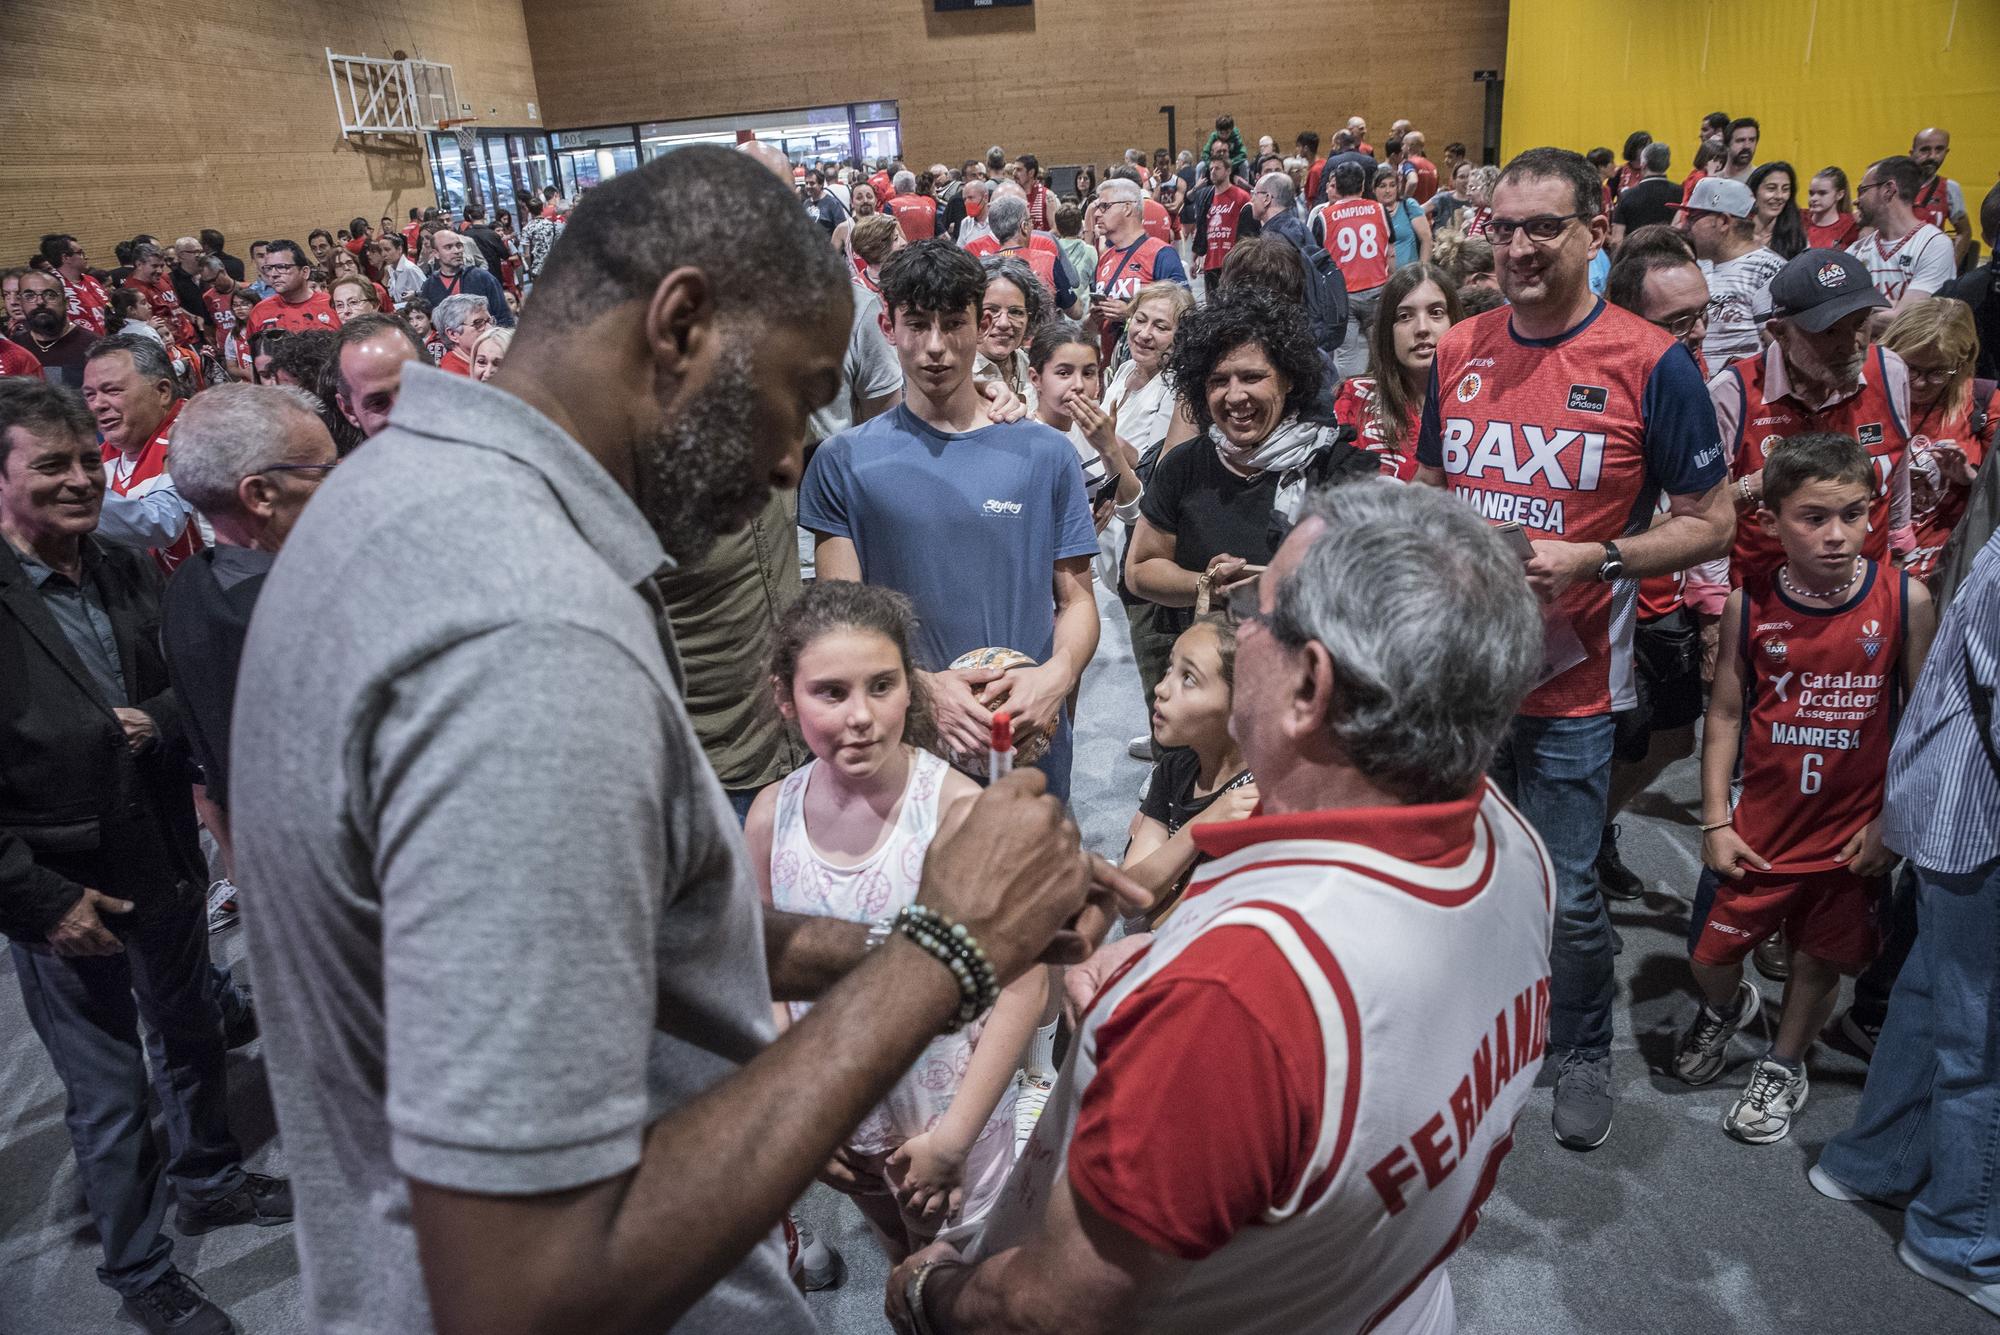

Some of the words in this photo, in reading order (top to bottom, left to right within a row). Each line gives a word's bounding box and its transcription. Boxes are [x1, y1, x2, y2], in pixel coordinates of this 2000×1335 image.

[1331, 204, 1376, 221] CAMPIONS
[1337, 223, 1378, 263] 98
[1819, 267, 1846, 282] BAXI
[1442, 417, 1607, 491] BAXI
[1771, 721, 1861, 750] MANRESA
[1800, 752, 1824, 795] 6
[1366, 975, 1552, 1218] FERNAND
